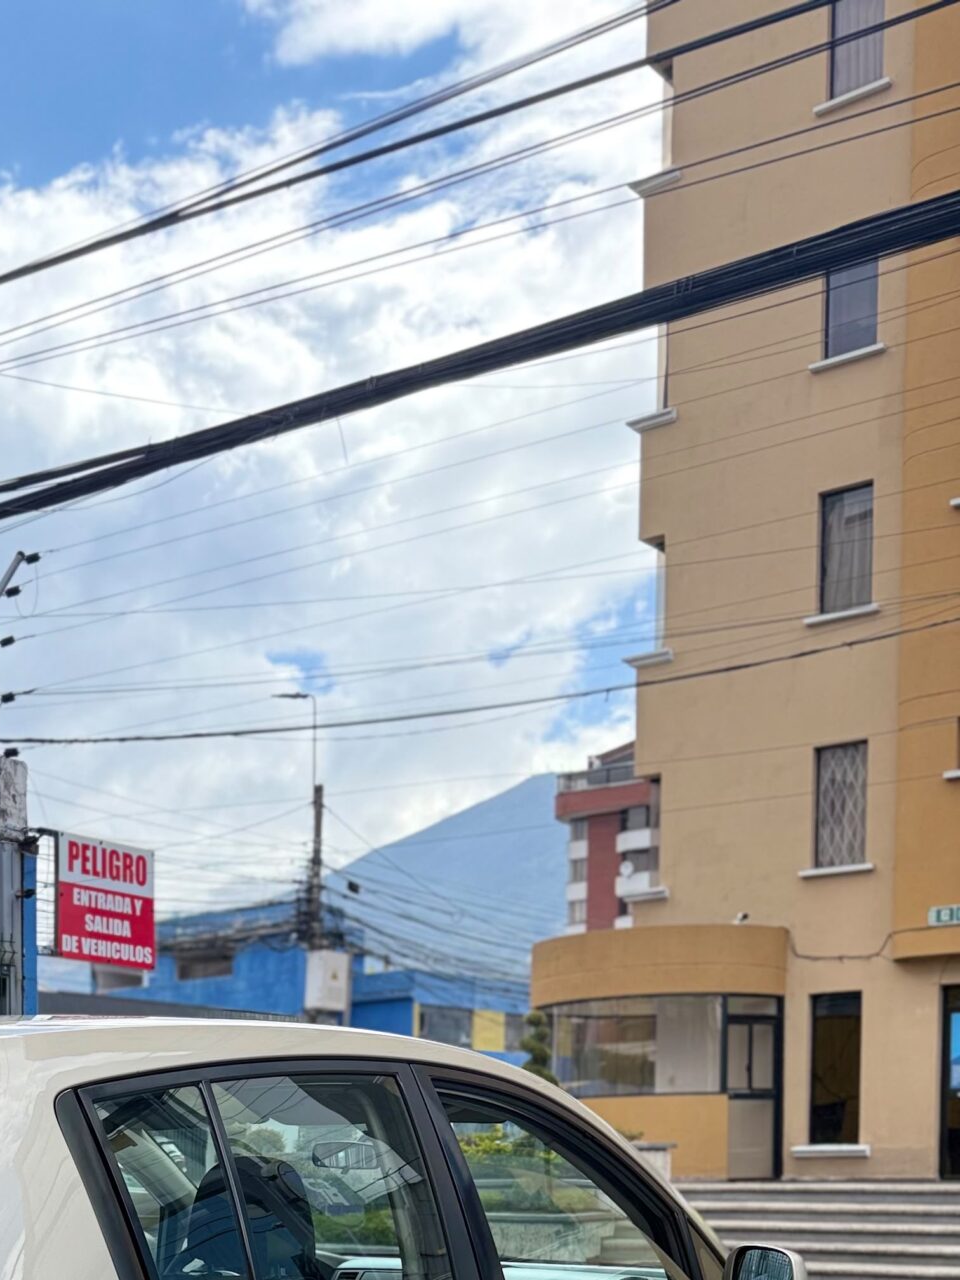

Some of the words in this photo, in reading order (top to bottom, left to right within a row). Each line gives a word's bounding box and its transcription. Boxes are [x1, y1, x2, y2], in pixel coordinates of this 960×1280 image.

[68, 841, 146, 886] PELIGRO
[73, 888, 131, 914] ENTRADA
[133, 899, 143, 916] Y
[85, 914, 131, 936] SALIDA
[62, 934, 79, 953] DE
[81, 937, 152, 963] VEHICULOS
